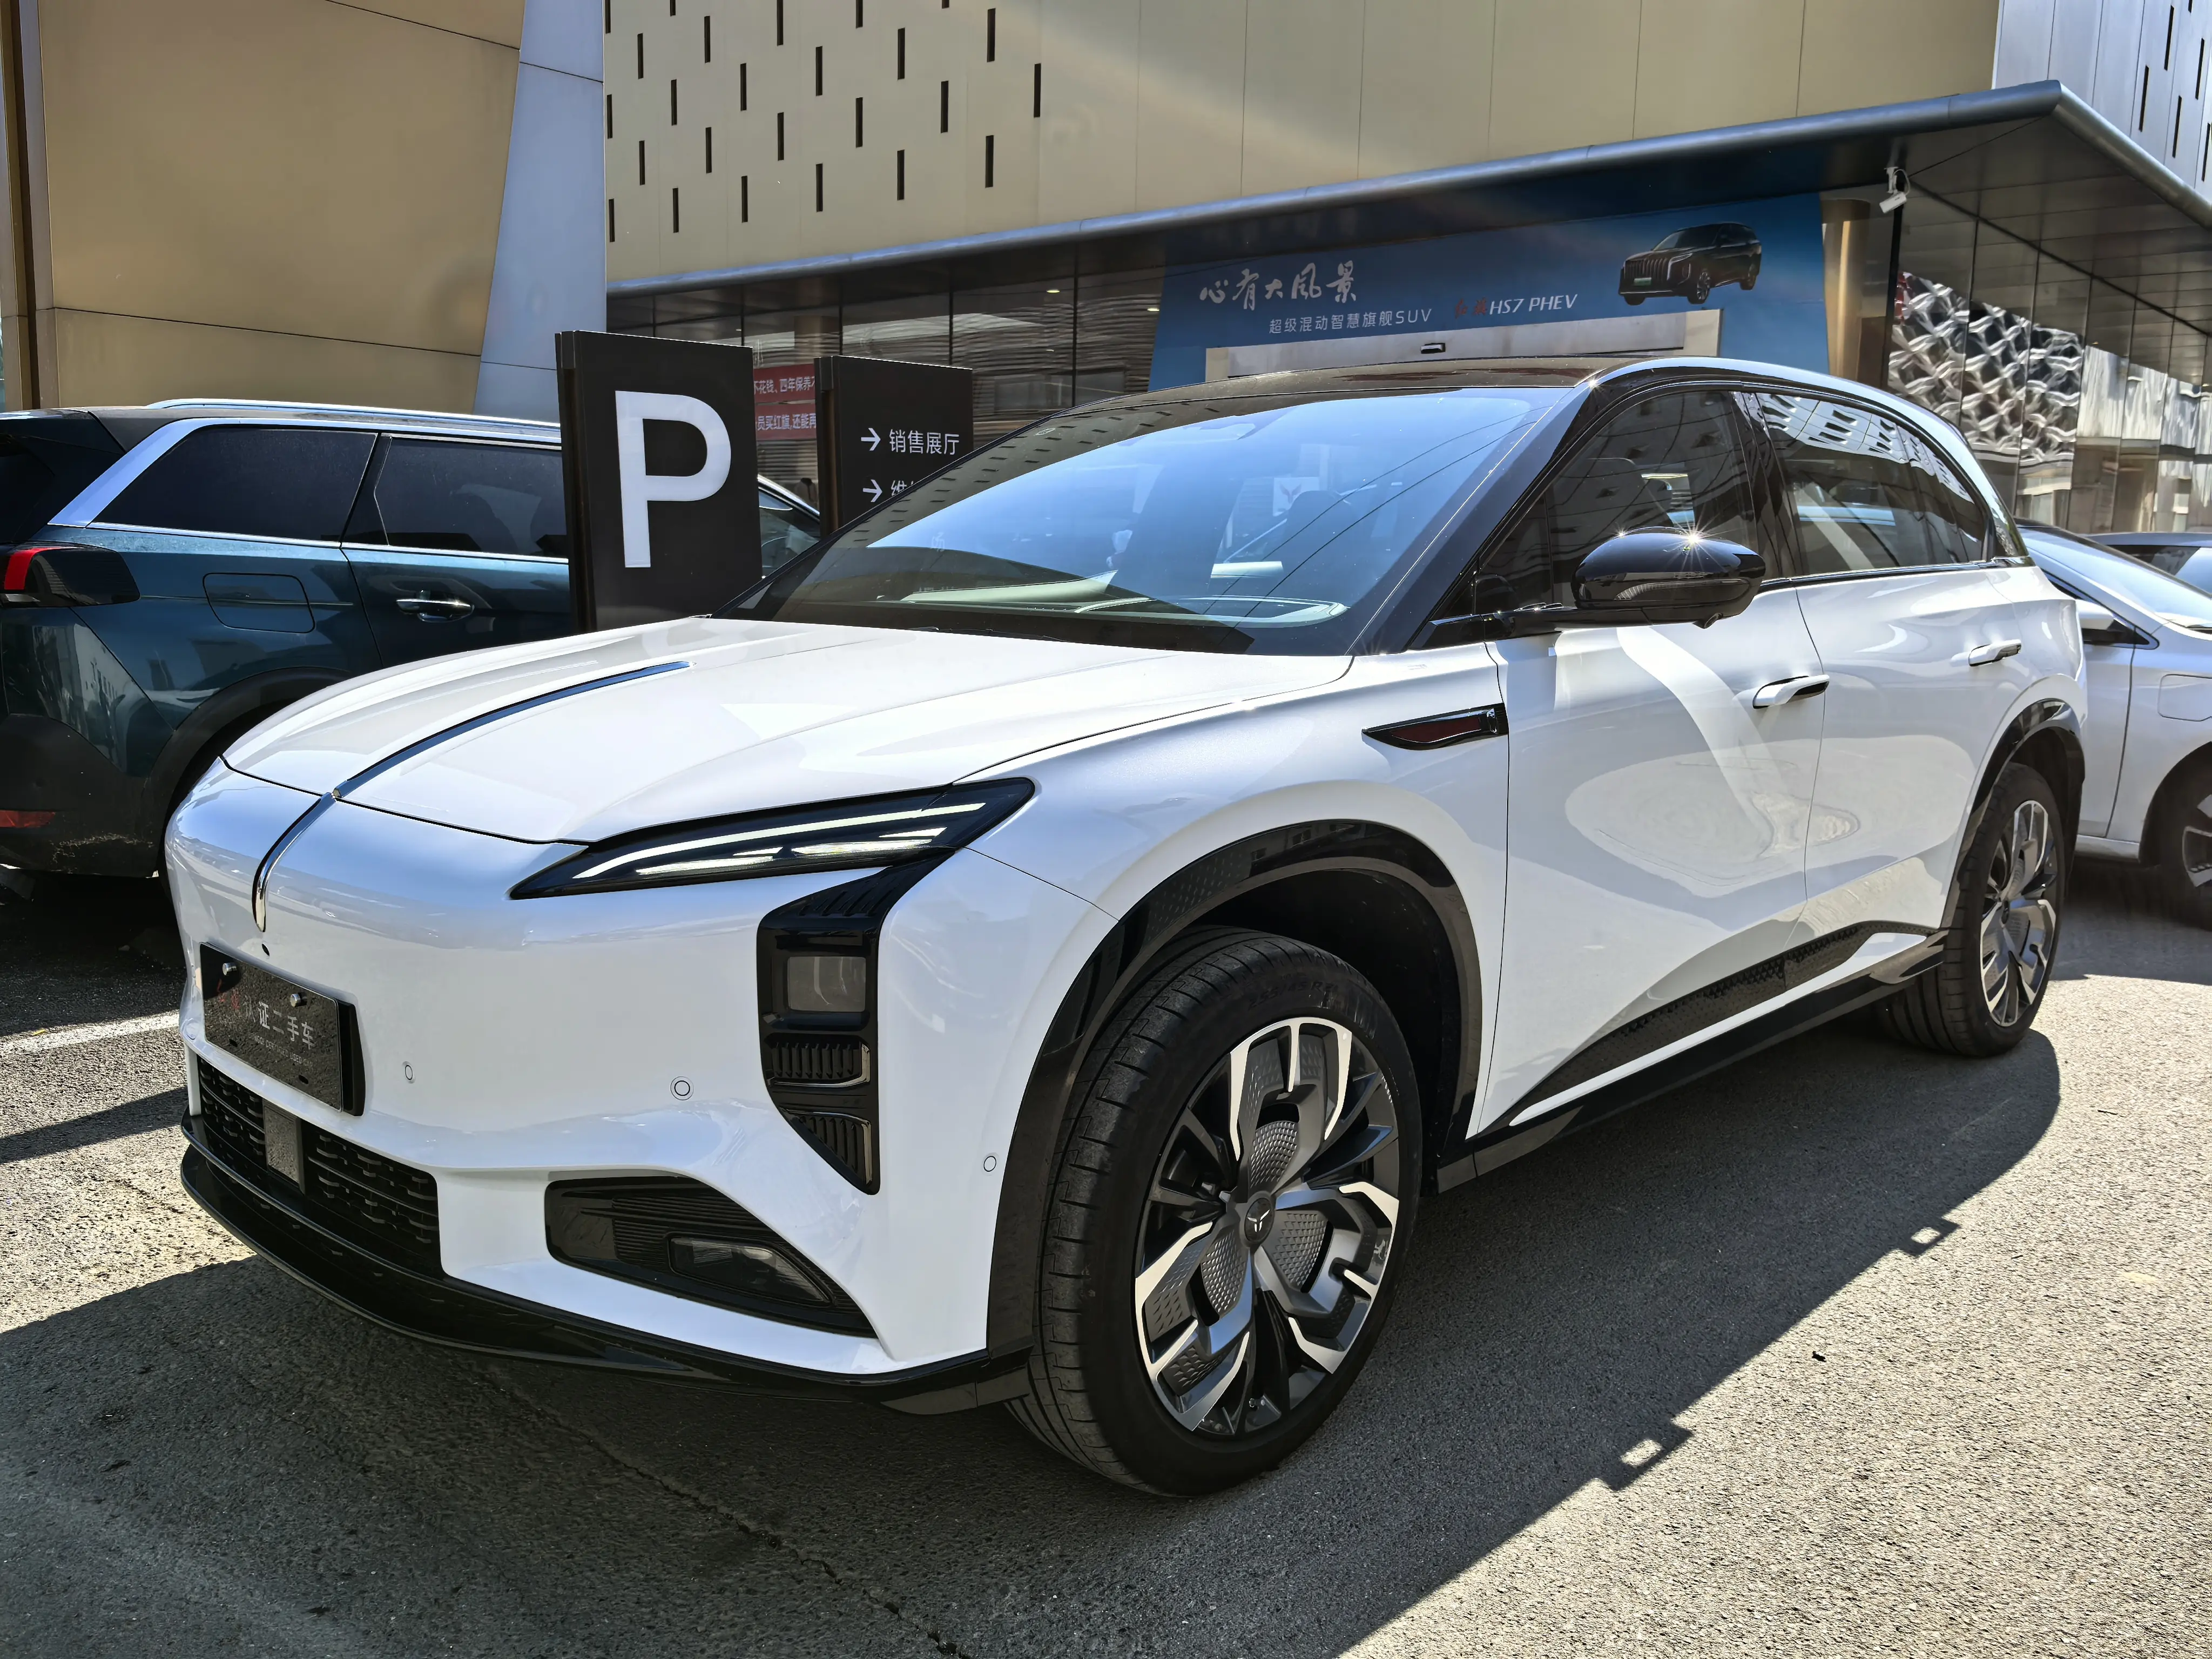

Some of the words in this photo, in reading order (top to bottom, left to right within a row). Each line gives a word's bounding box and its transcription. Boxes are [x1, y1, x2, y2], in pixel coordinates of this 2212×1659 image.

[1199, 260, 1357, 311] 心有大风景
[1529, 294, 1578, 312] PHEV
[1269, 308, 1433, 334] 超级混动智慧旗舰SUV
[889, 429, 960, 455] 销售展厅
[615, 390, 732, 568] P
[289, 1052, 302, 1064] USED
